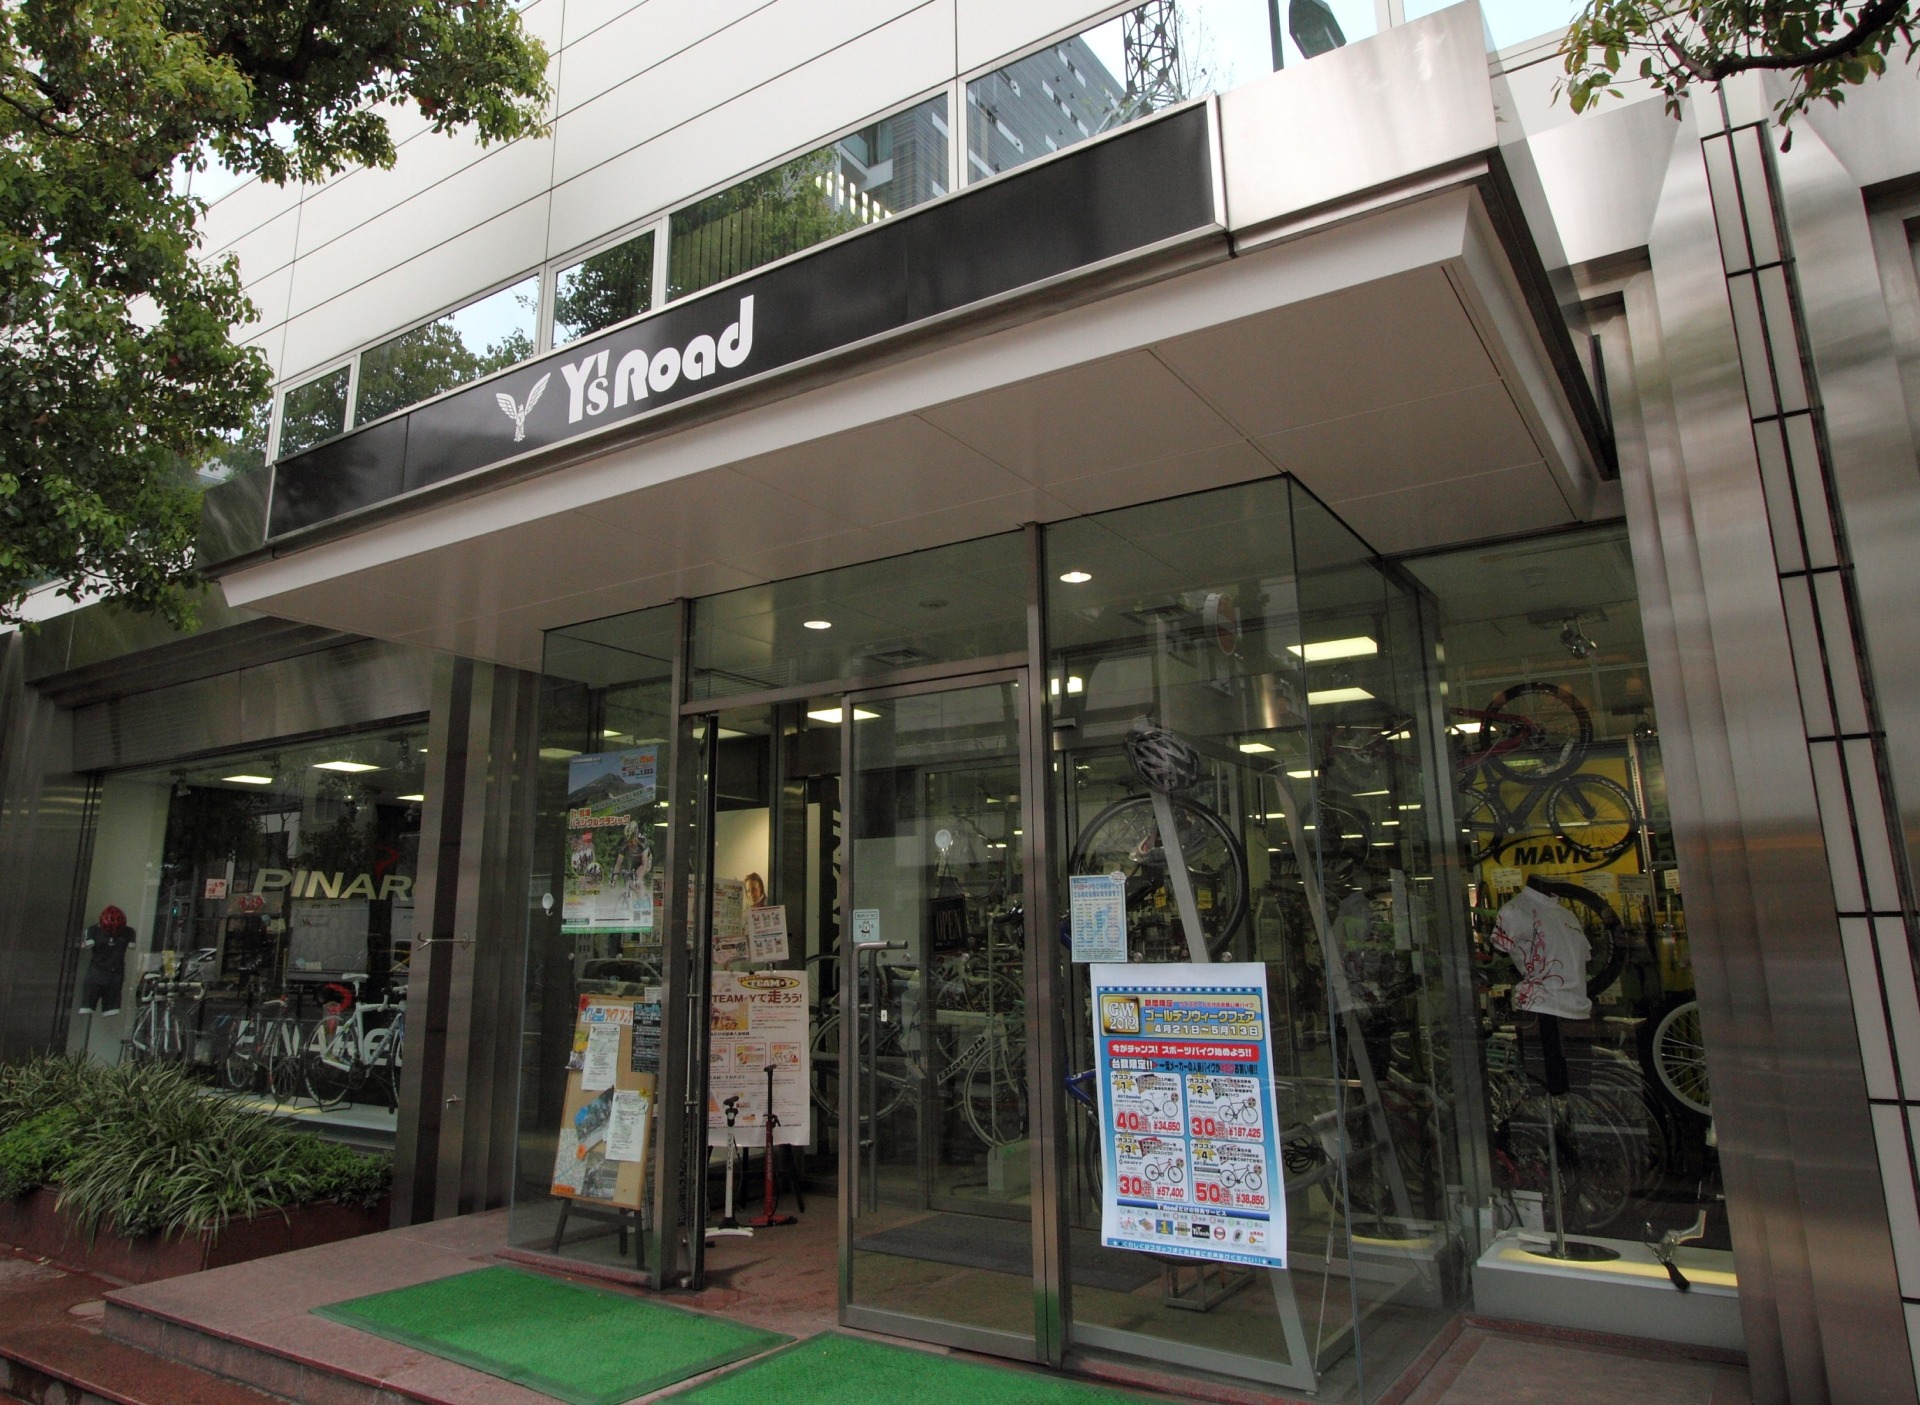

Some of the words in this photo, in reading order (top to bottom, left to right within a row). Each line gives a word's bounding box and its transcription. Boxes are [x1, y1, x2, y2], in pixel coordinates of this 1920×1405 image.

[560, 349, 610, 424] Y's
[613, 294, 754, 408] Road
[252, 868, 416, 900] PINAR
[1108, 1003, 1135, 1017] GW
[1145, 1010, 1255, 1023] ゴールデンウィークフェア
[1109, 1017, 1136, 1030] 2012
[939, 1037, 985, 1080] Bianchi
[1196, 1085, 1203, 1094] 2
[1125, 1145, 1131, 1153] 3
[1201, 1151, 1208, 1159] 4
